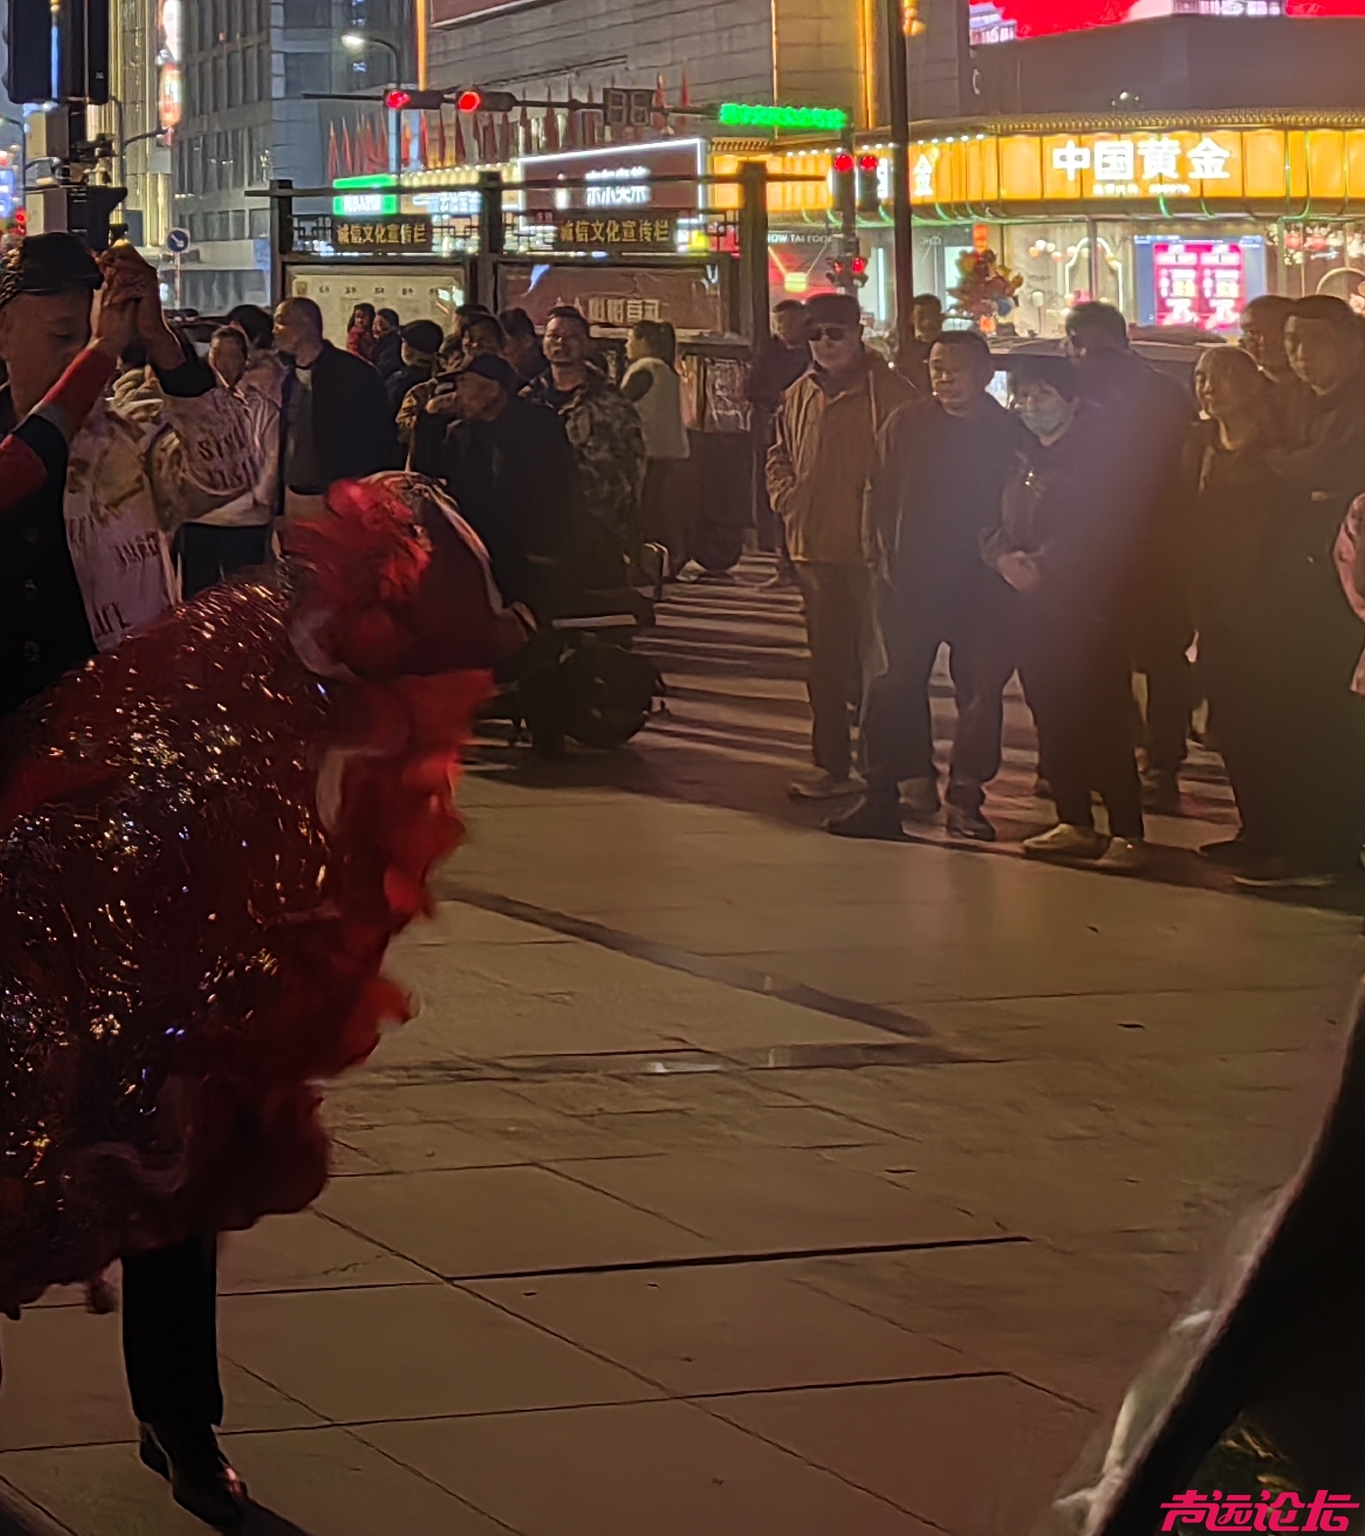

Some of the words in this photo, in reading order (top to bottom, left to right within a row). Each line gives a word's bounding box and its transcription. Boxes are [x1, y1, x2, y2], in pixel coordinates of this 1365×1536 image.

[1052, 138, 1231, 182] 中国黄金
[337, 223, 427, 244] 诚信文化宣传栏
[561, 219, 669, 242] 诚信文化宣传栏
